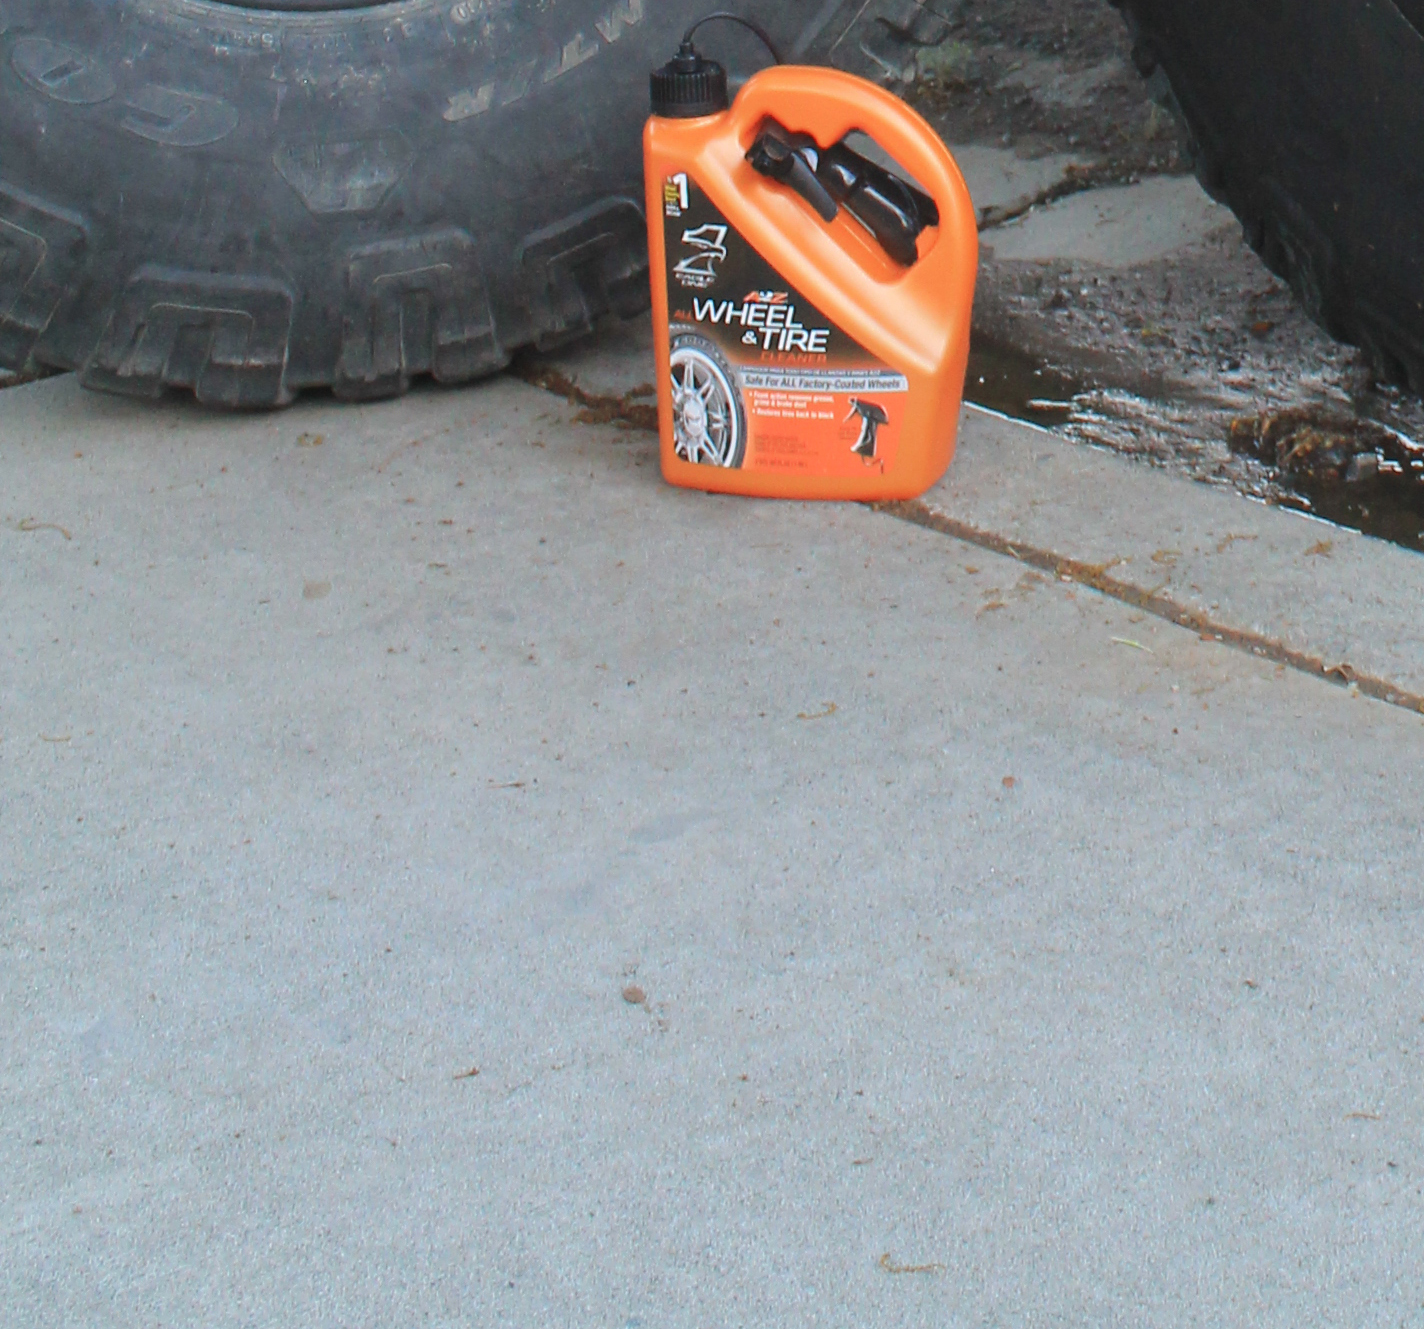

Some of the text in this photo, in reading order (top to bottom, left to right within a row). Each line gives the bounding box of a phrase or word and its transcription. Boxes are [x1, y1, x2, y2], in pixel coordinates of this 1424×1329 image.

[743, 290, 788, 304] A2Z
[693, 297, 803, 329] WHEEL
[758, 326, 831, 354] TIRE
[760, 352, 828, 365] CLEANER
[745, 375, 901, 390] Safe For ALL Factory-Coated Wheels
